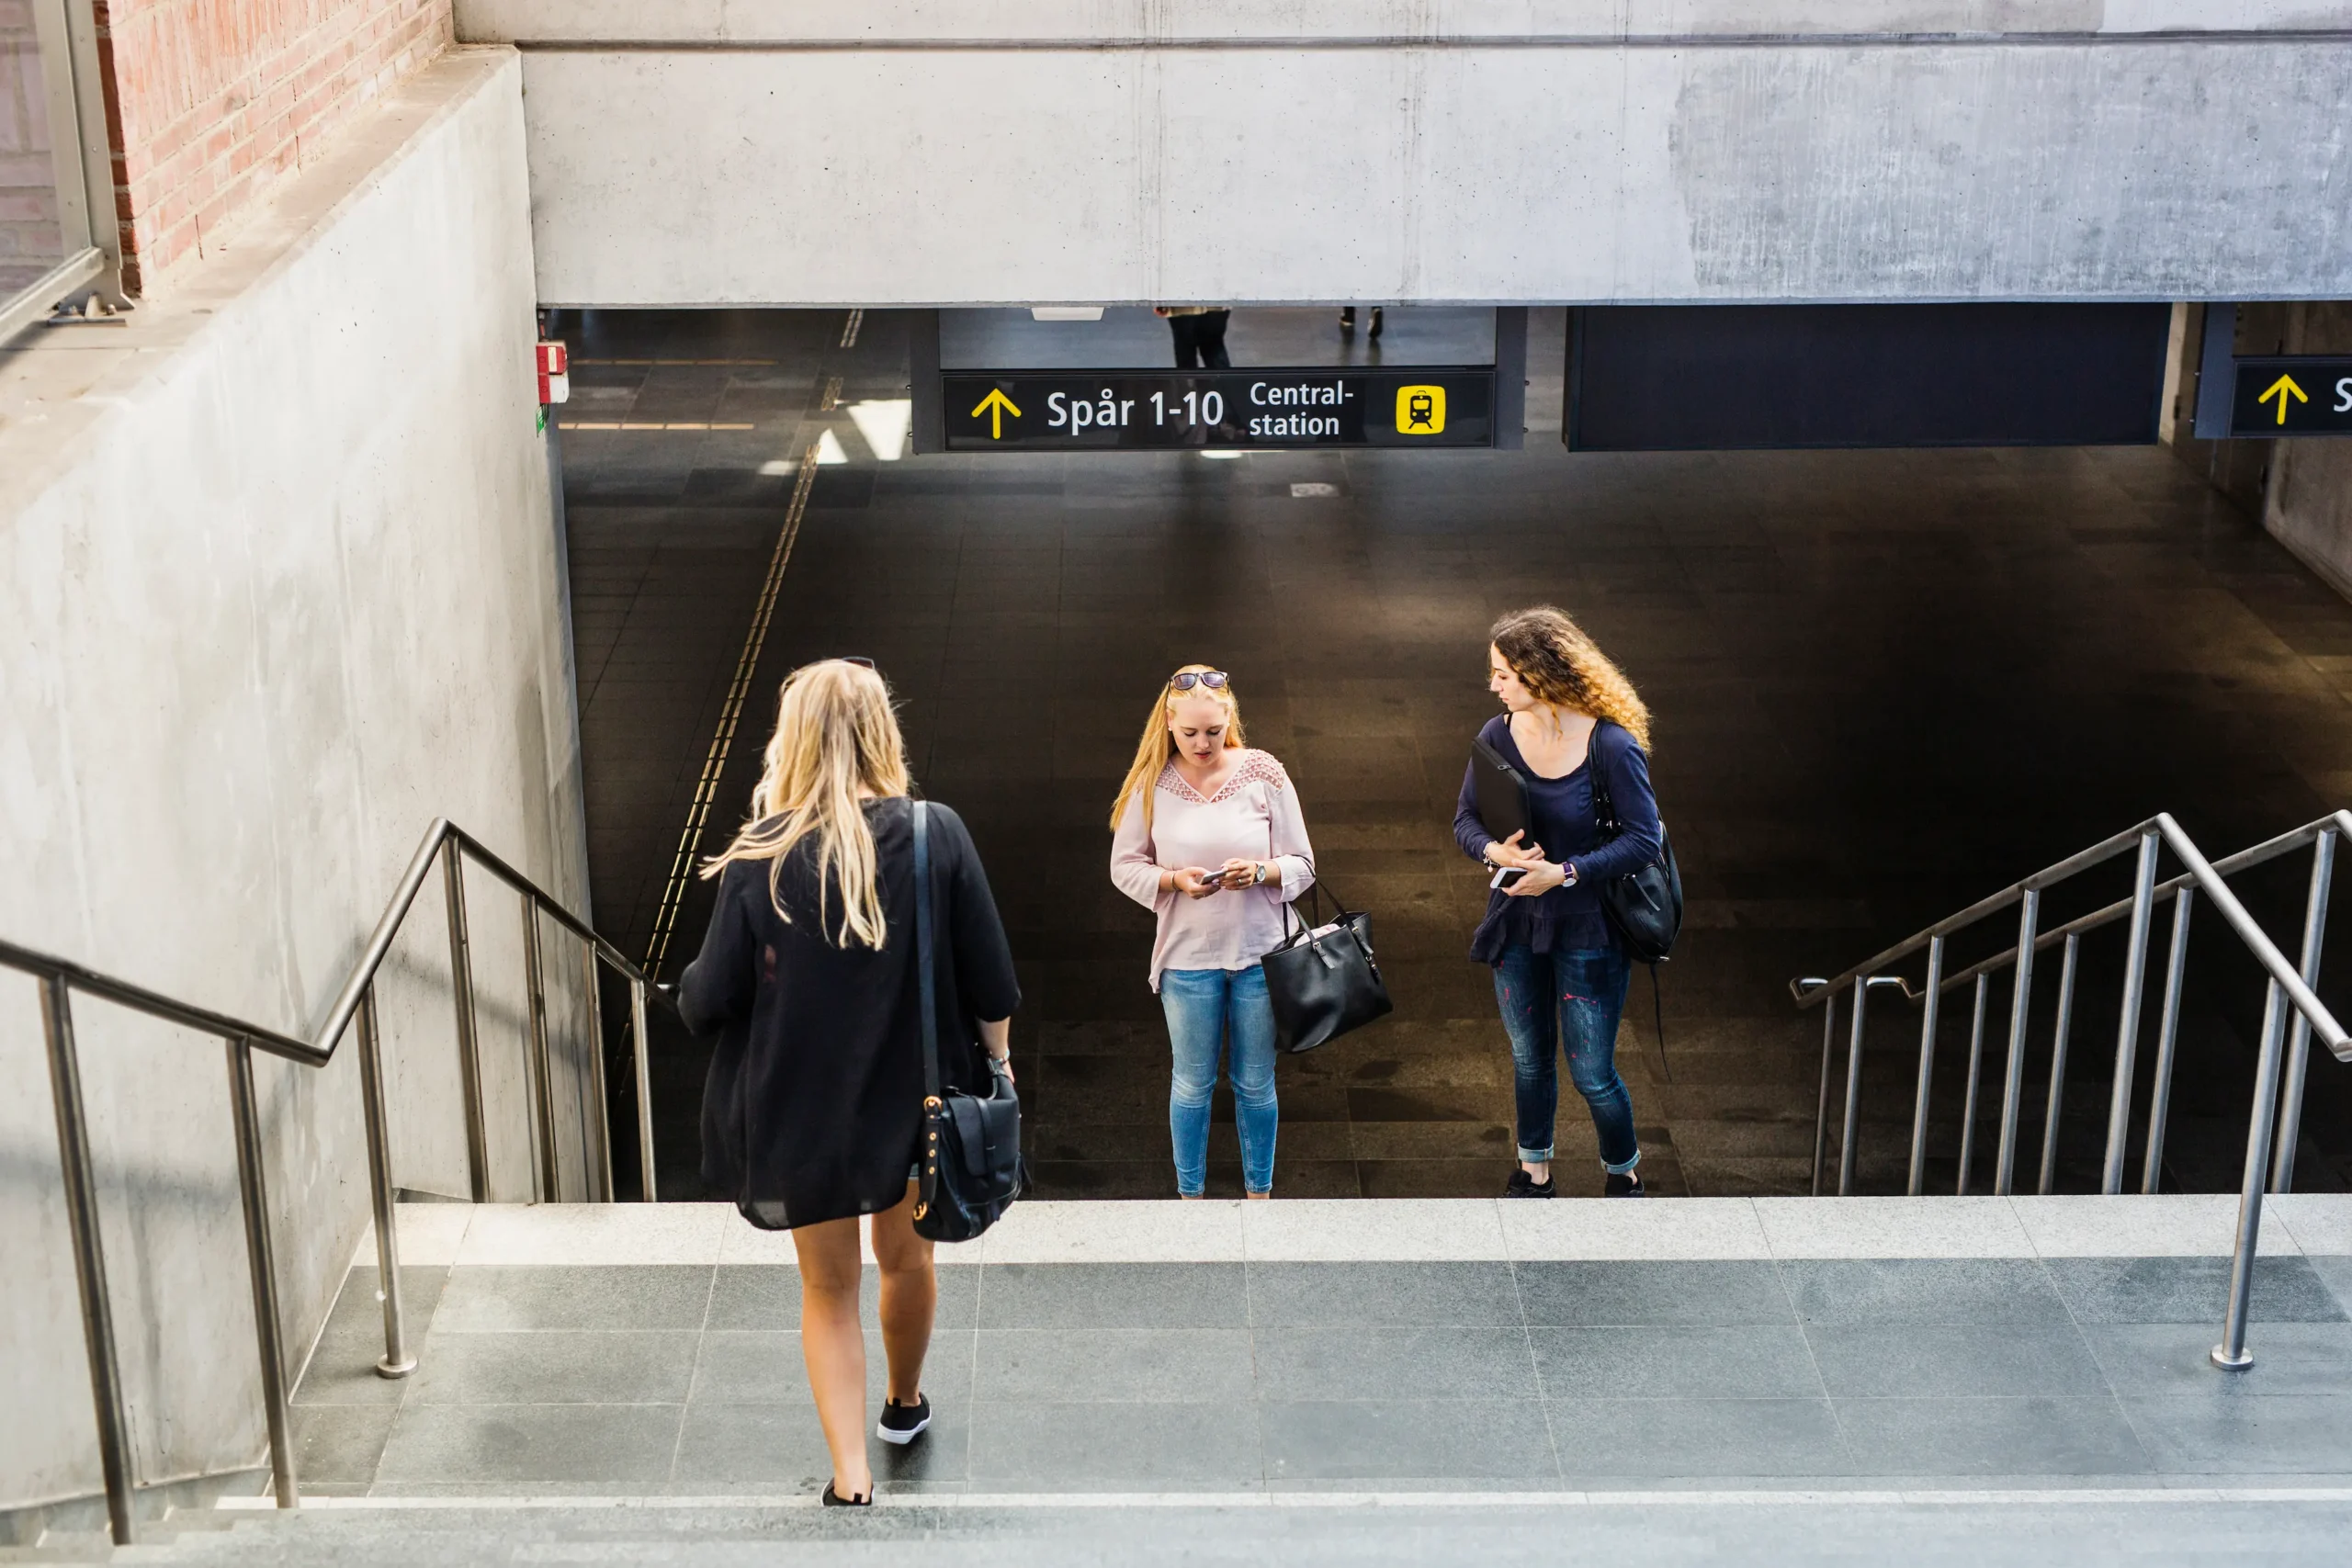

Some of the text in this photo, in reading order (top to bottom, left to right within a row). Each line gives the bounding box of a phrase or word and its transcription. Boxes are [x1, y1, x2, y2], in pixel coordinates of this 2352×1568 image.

[1250, 379, 1354, 406] Central-
[2333, 377, 2352, 412] S
[1047, 388, 1224, 436] Spår 1-10
[1250, 411, 1340, 436] station
